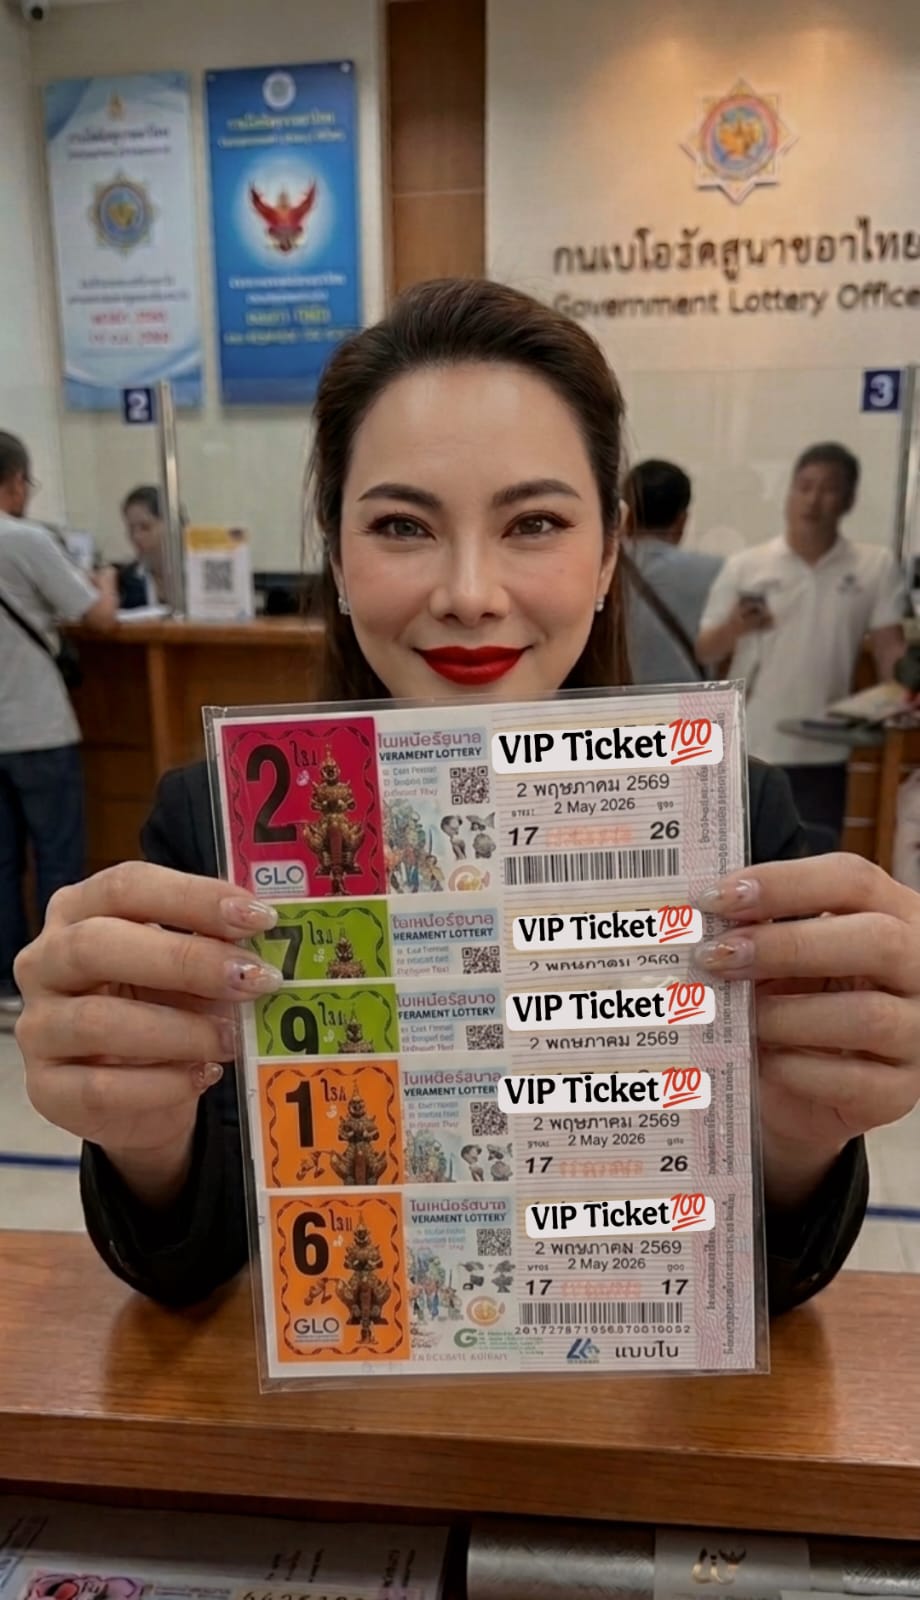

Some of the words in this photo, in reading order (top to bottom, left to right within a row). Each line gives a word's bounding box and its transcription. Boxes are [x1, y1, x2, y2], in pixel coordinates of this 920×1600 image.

[553, 290, 719, 319] Government
[729, 285, 826, 317] Lottery
[838, 281, 920, 309] Office
[869, 374, 894, 407] 3
[129, 392, 148, 418] 2
[436, 747, 482, 758] LOTTERY
[246, 744, 297, 843] 2
[517, 782, 527, 798] 2
[626, 774, 670, 792] 2569
[554, 802, 562, 814] 2
[567, 799, 597, 818] May
[600, 797, 636, 812] 2026
[508, 826, 539, 847] 17
[650, 820, 680, 841] 26
[255, 865, 305, 885] GLO
[449, 927, 494, 938] LOTTERY
[452, 1006, 496, 1017] LOTTERY
[636, 1030, 679, 1047] 2569
[404, 1087, 456, 1097] VERAMENT
[458, 1085, 498, 1095] LOTTER
[285, 1080, 314, 1148] 1
[533, 1116, 544, 1131] 2
[638, 1112, 681, 1128] 2569
[567, 1134, 577, 1147] 2
[580, 1133, 608, 1150] May
[612, 1132, 647, 1145] 2026
[525, 1156, 554, 1174] 17
[659, 1155, 689, 1173] 26
[411, 1214, 463, 1224] VERAMENT
[464, 1212, 506, 1222] LOTTERY
[291, 1211, 330, 1277] 6
[535, 1241, 545, 1255] 2
[639, 1240, 683, 1254] 2569
[567, 1258, 577, 1270] 2
[580, 1257, 609, 1273] May
[612, 1257, 647, 1270] 2026
[525, 1279, 553, 1296] 17
[661, 1279, 689, 1296] 17
[293, 1316, 341, 1335] GLO
